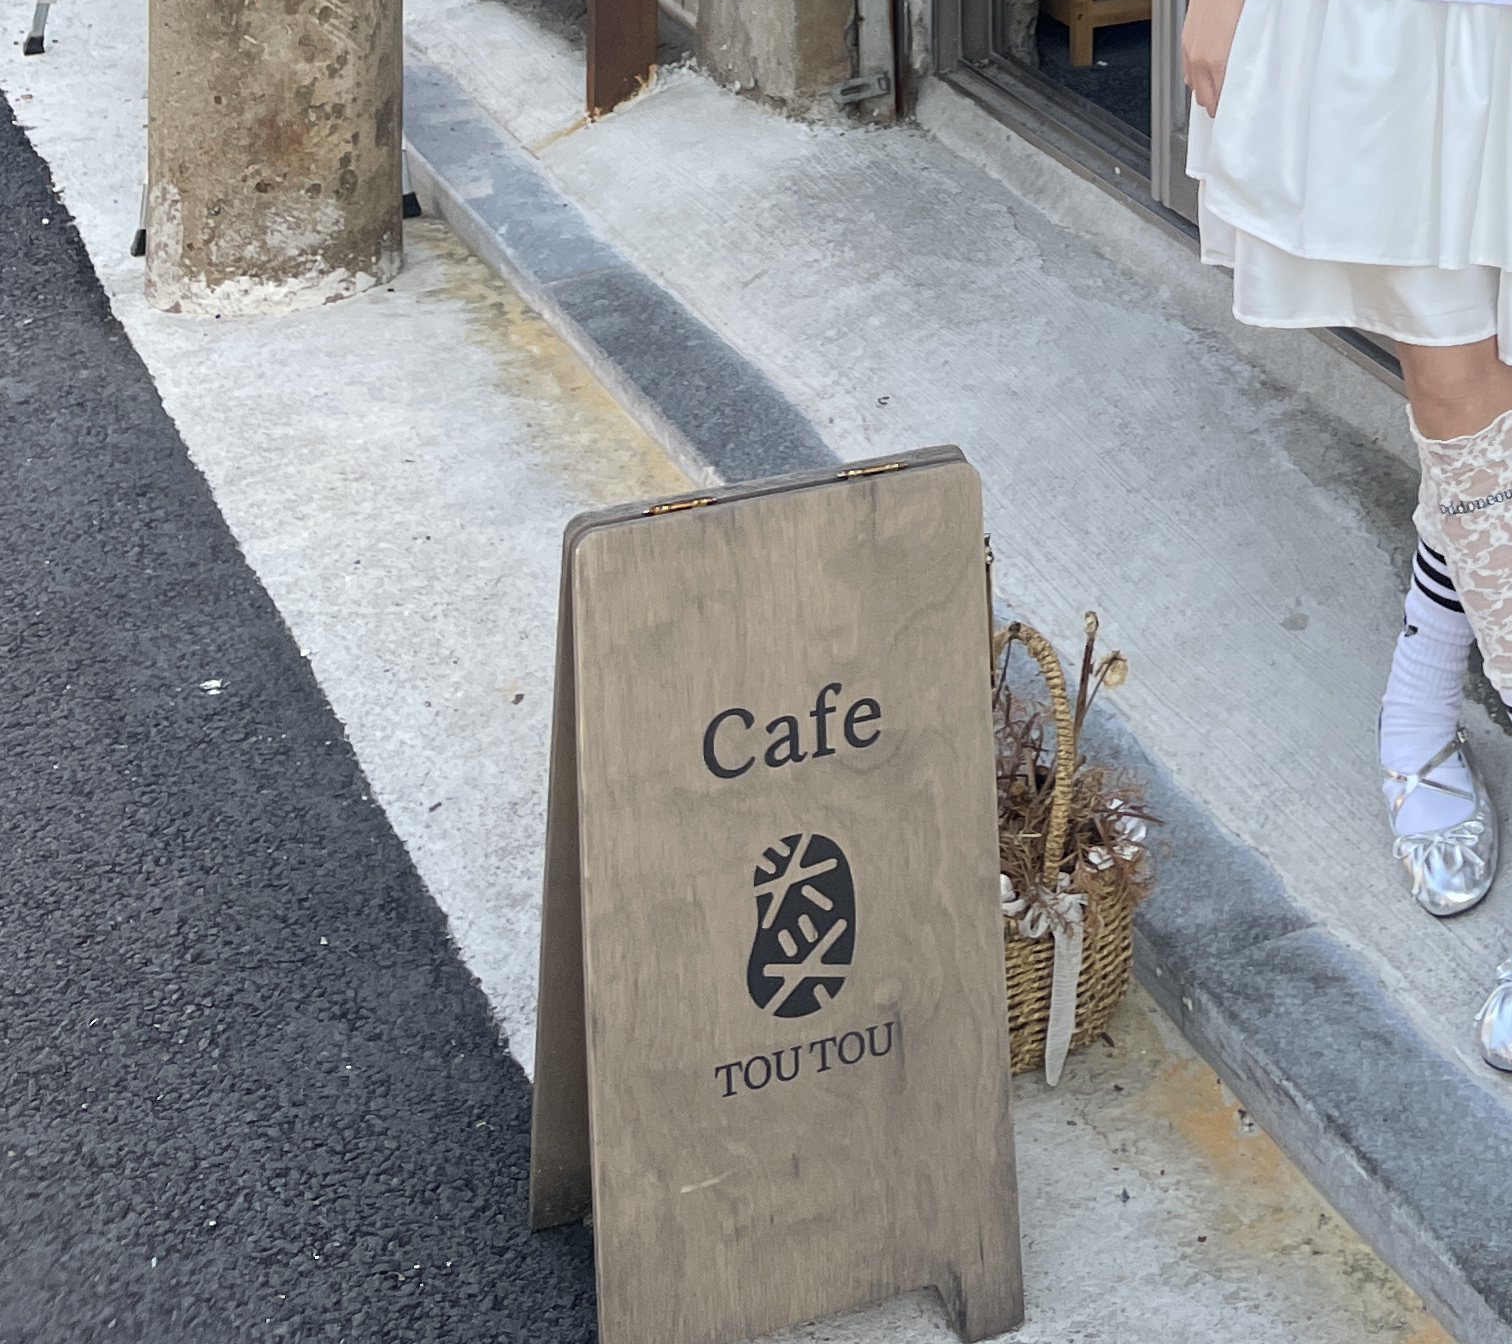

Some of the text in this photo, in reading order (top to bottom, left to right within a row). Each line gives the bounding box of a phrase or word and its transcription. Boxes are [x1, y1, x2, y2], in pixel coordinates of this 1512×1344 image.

[702, 682, 883, 780] Cafe
[714, 1021, 895, 1099] TOU TOU
